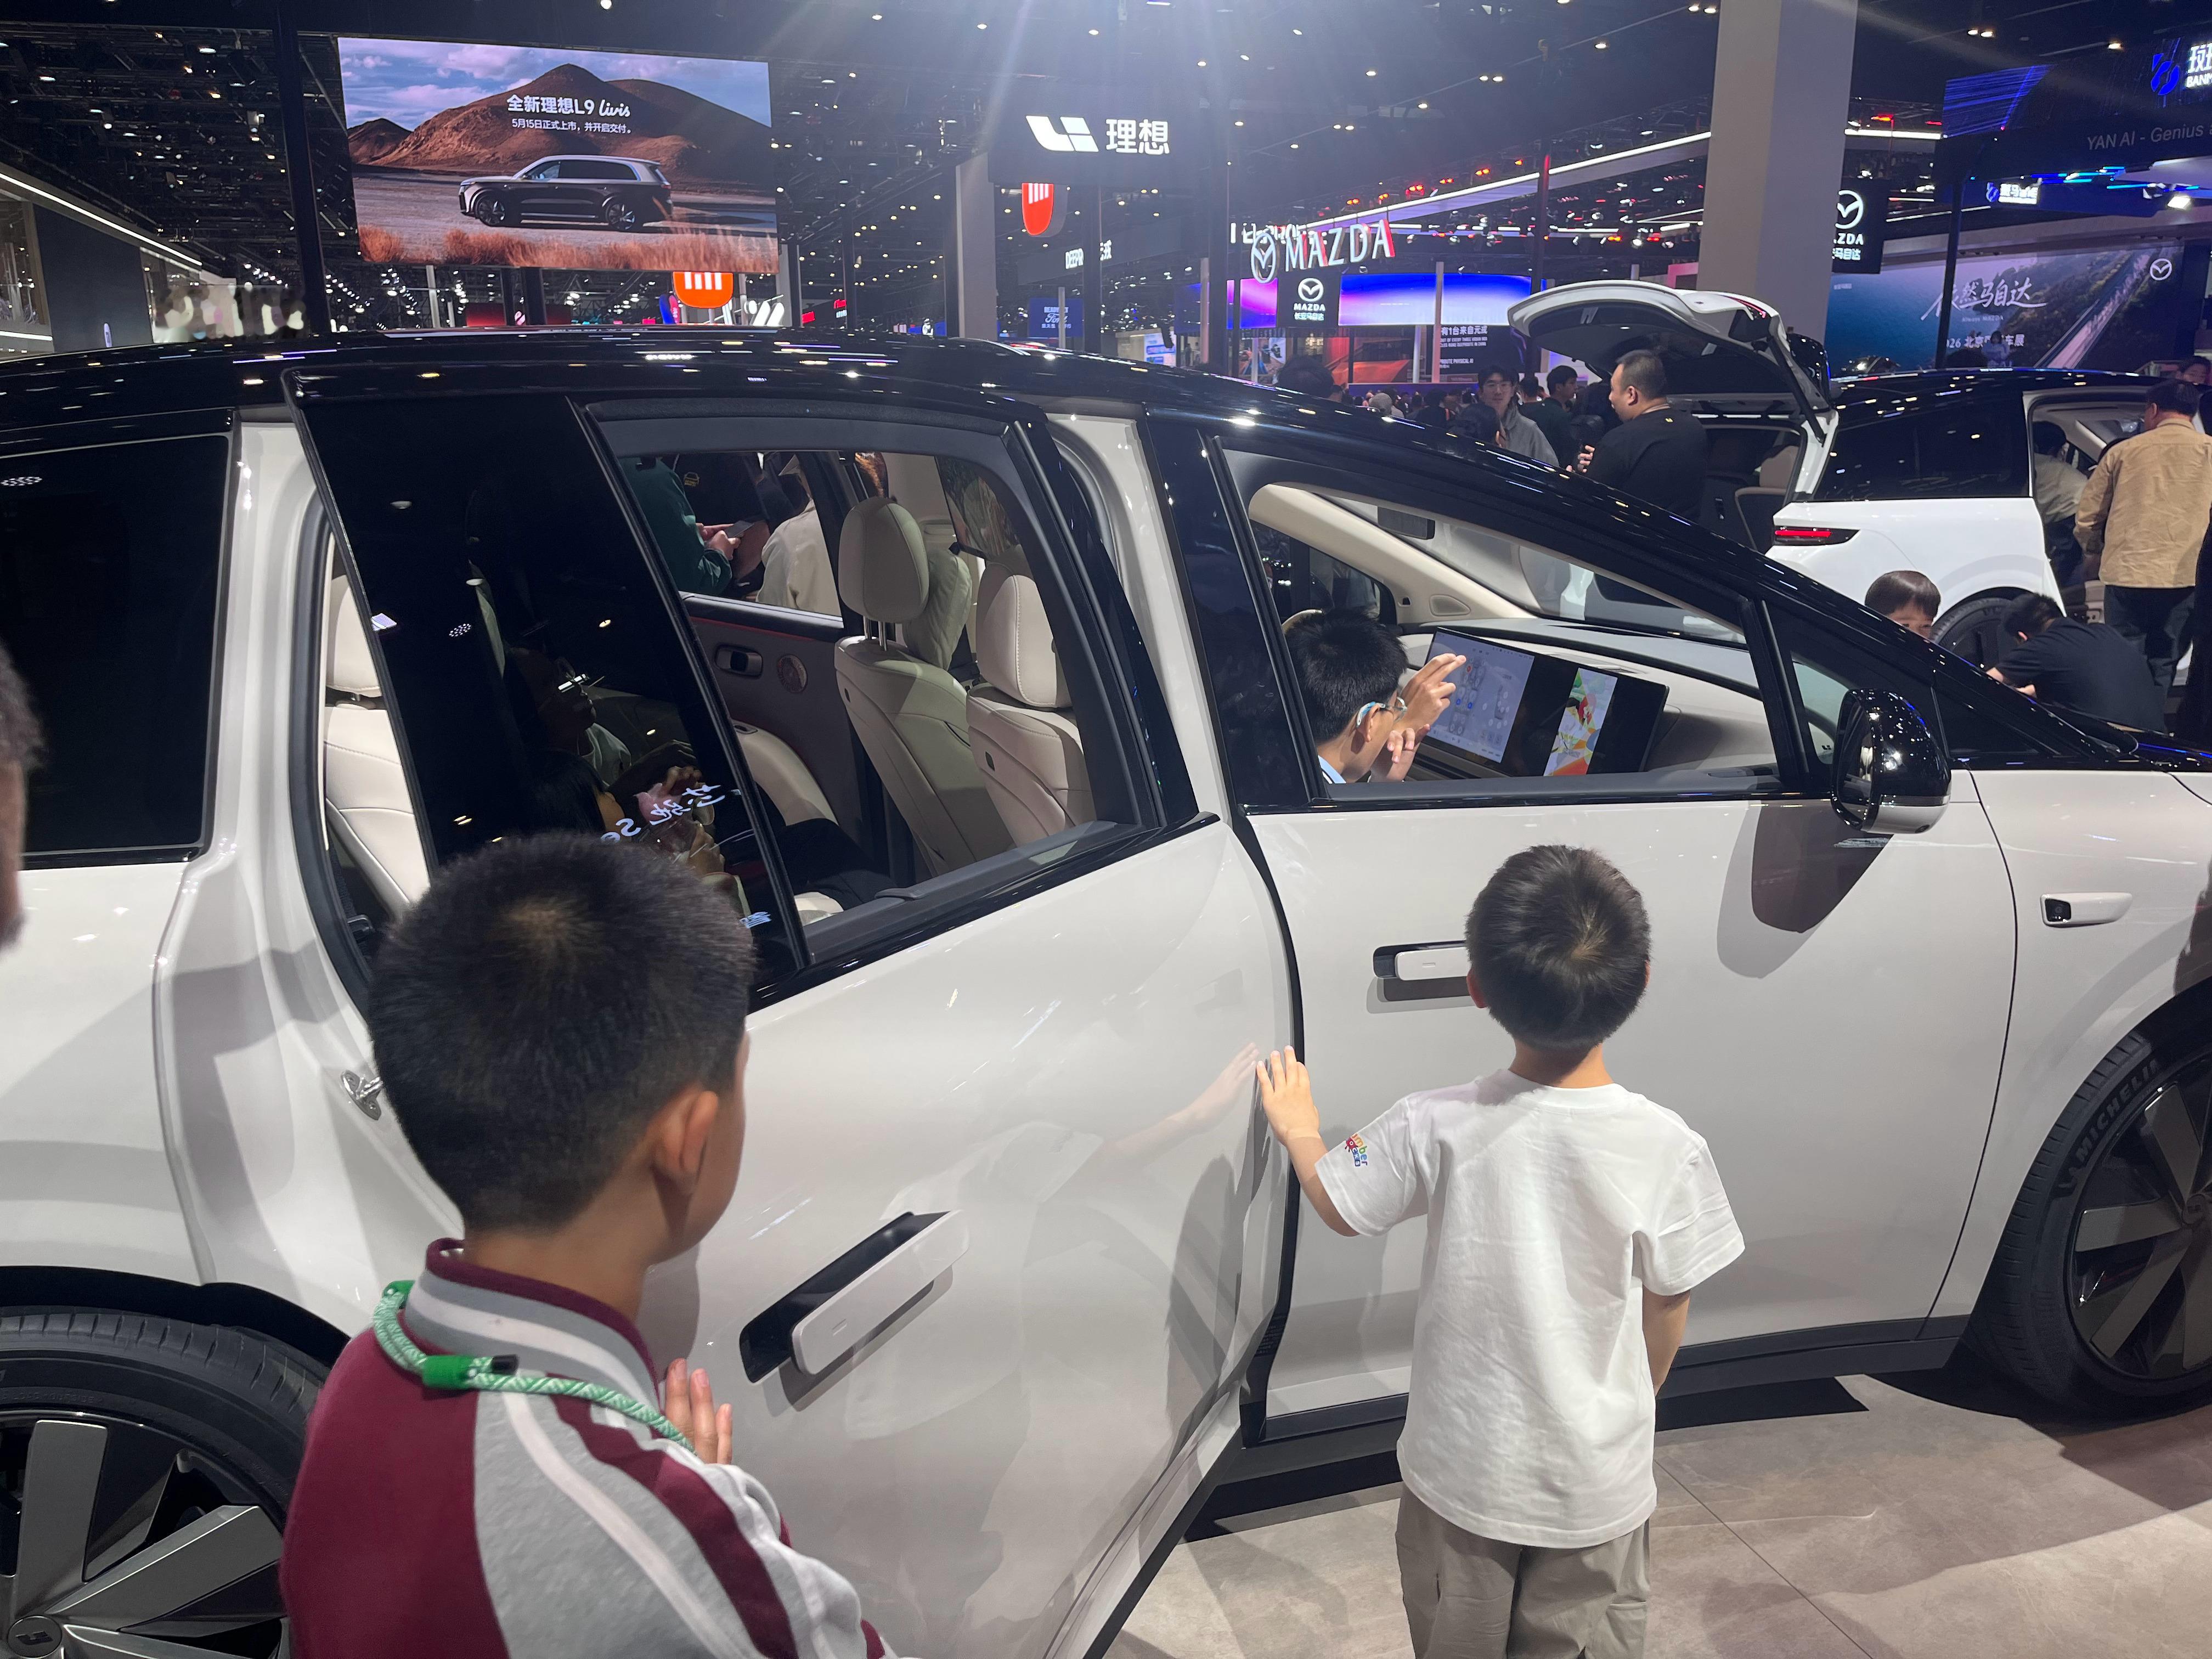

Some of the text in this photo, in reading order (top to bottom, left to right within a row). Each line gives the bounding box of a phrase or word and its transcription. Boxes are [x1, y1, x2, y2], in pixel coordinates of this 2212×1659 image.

[507, 94, 595, 115] 全新理想L9
[1105, 119, 1170, 155] 理想
[2088, 133, 2116, 150] YAN
[2120, 131, 2135, 146] AI
[2151, 124, 2204, 142] Genius
[1285, 219, 1396, 272] MAZDA
[1833, 233, 1864, 245] ZDA
[1832, 247, 1861, 261] 马自达
[1293, 303, 1326, 312] MAZDA
[1351, 1133, 1368, 1166] mber
